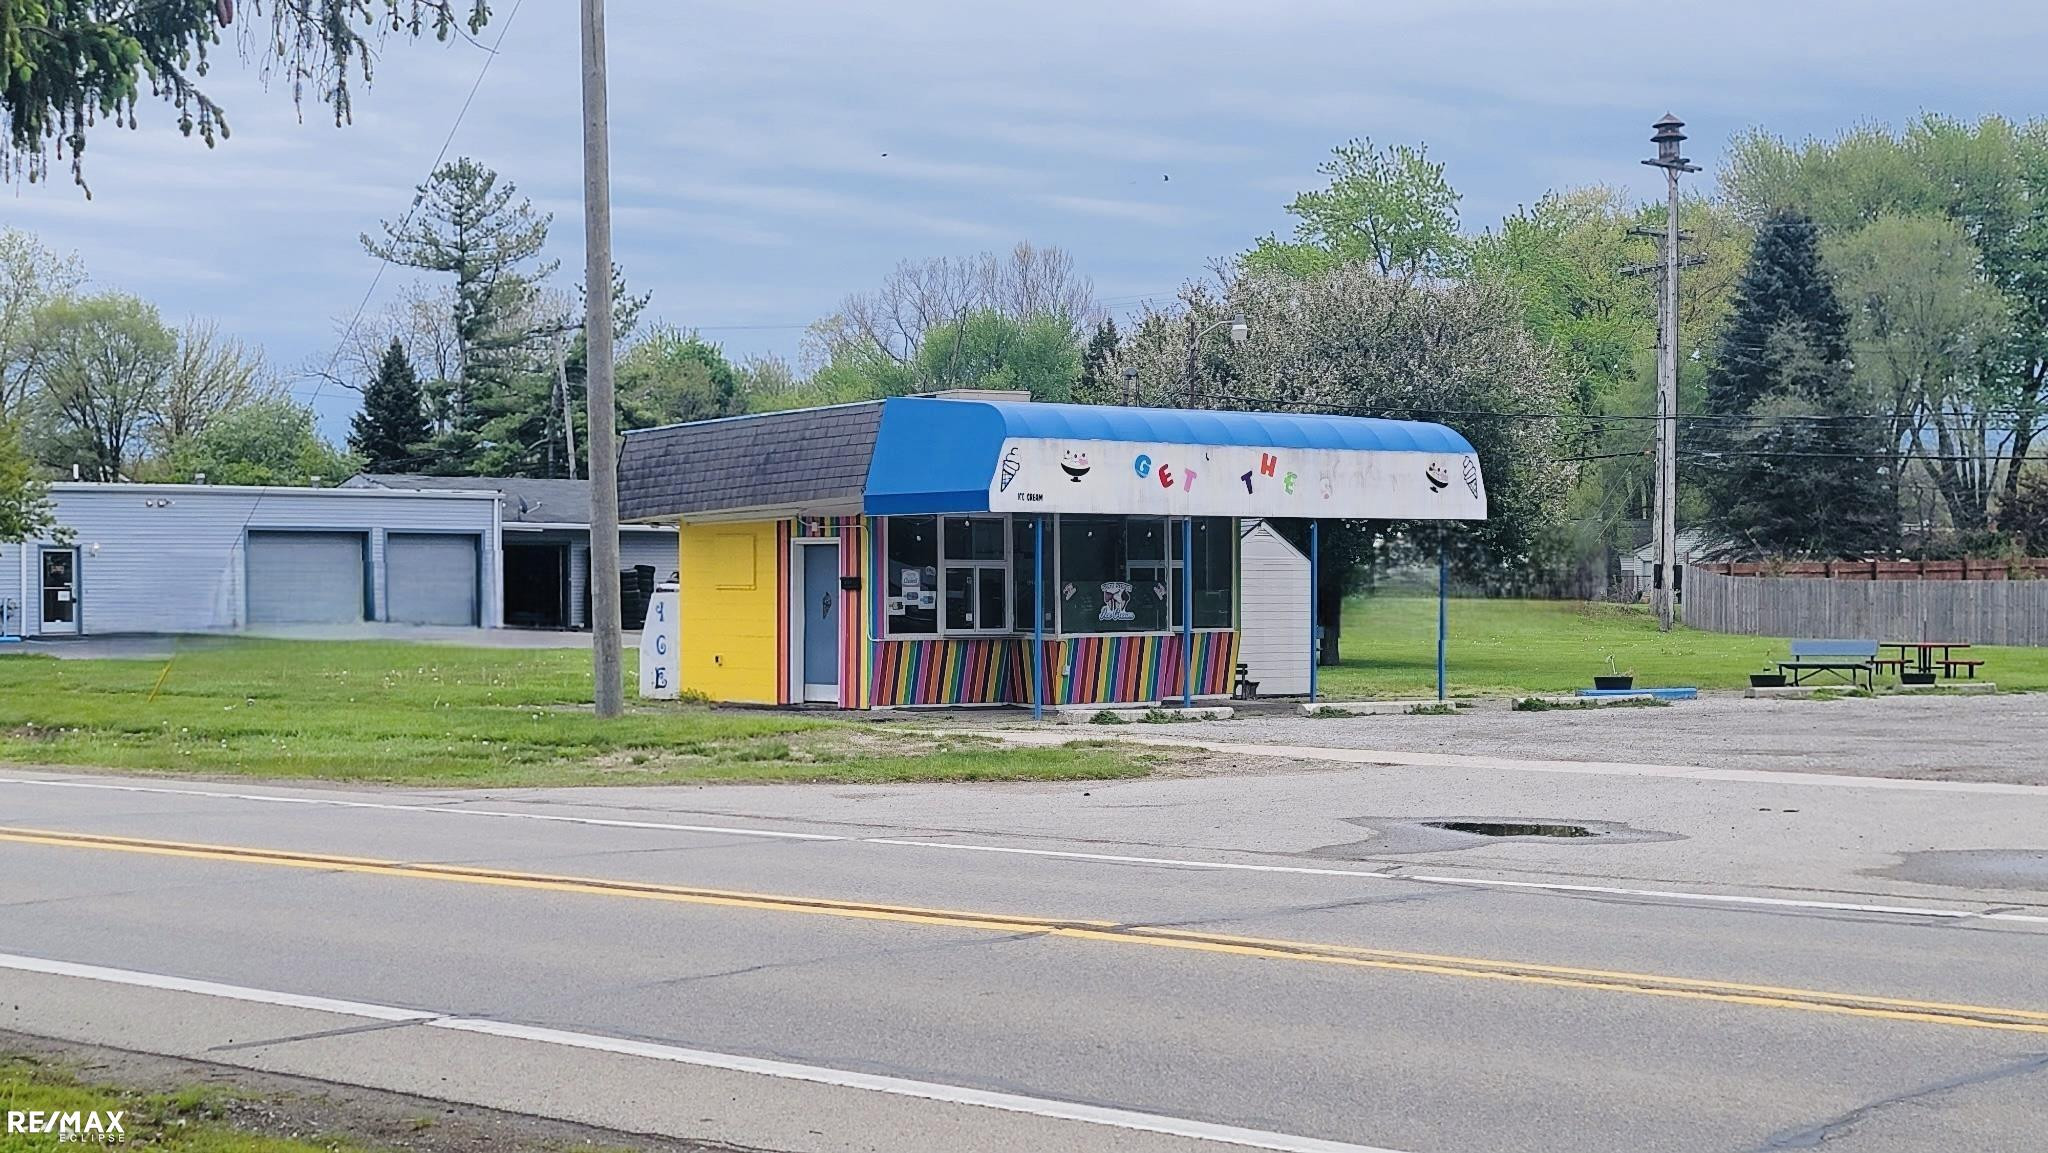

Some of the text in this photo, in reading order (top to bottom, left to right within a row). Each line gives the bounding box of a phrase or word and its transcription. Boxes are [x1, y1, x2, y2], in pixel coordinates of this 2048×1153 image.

[1134, 454, 1198, 493] GET
[1240, 452, 1298, 495] THE
[1026, 493, 1044, 502] CREAM
